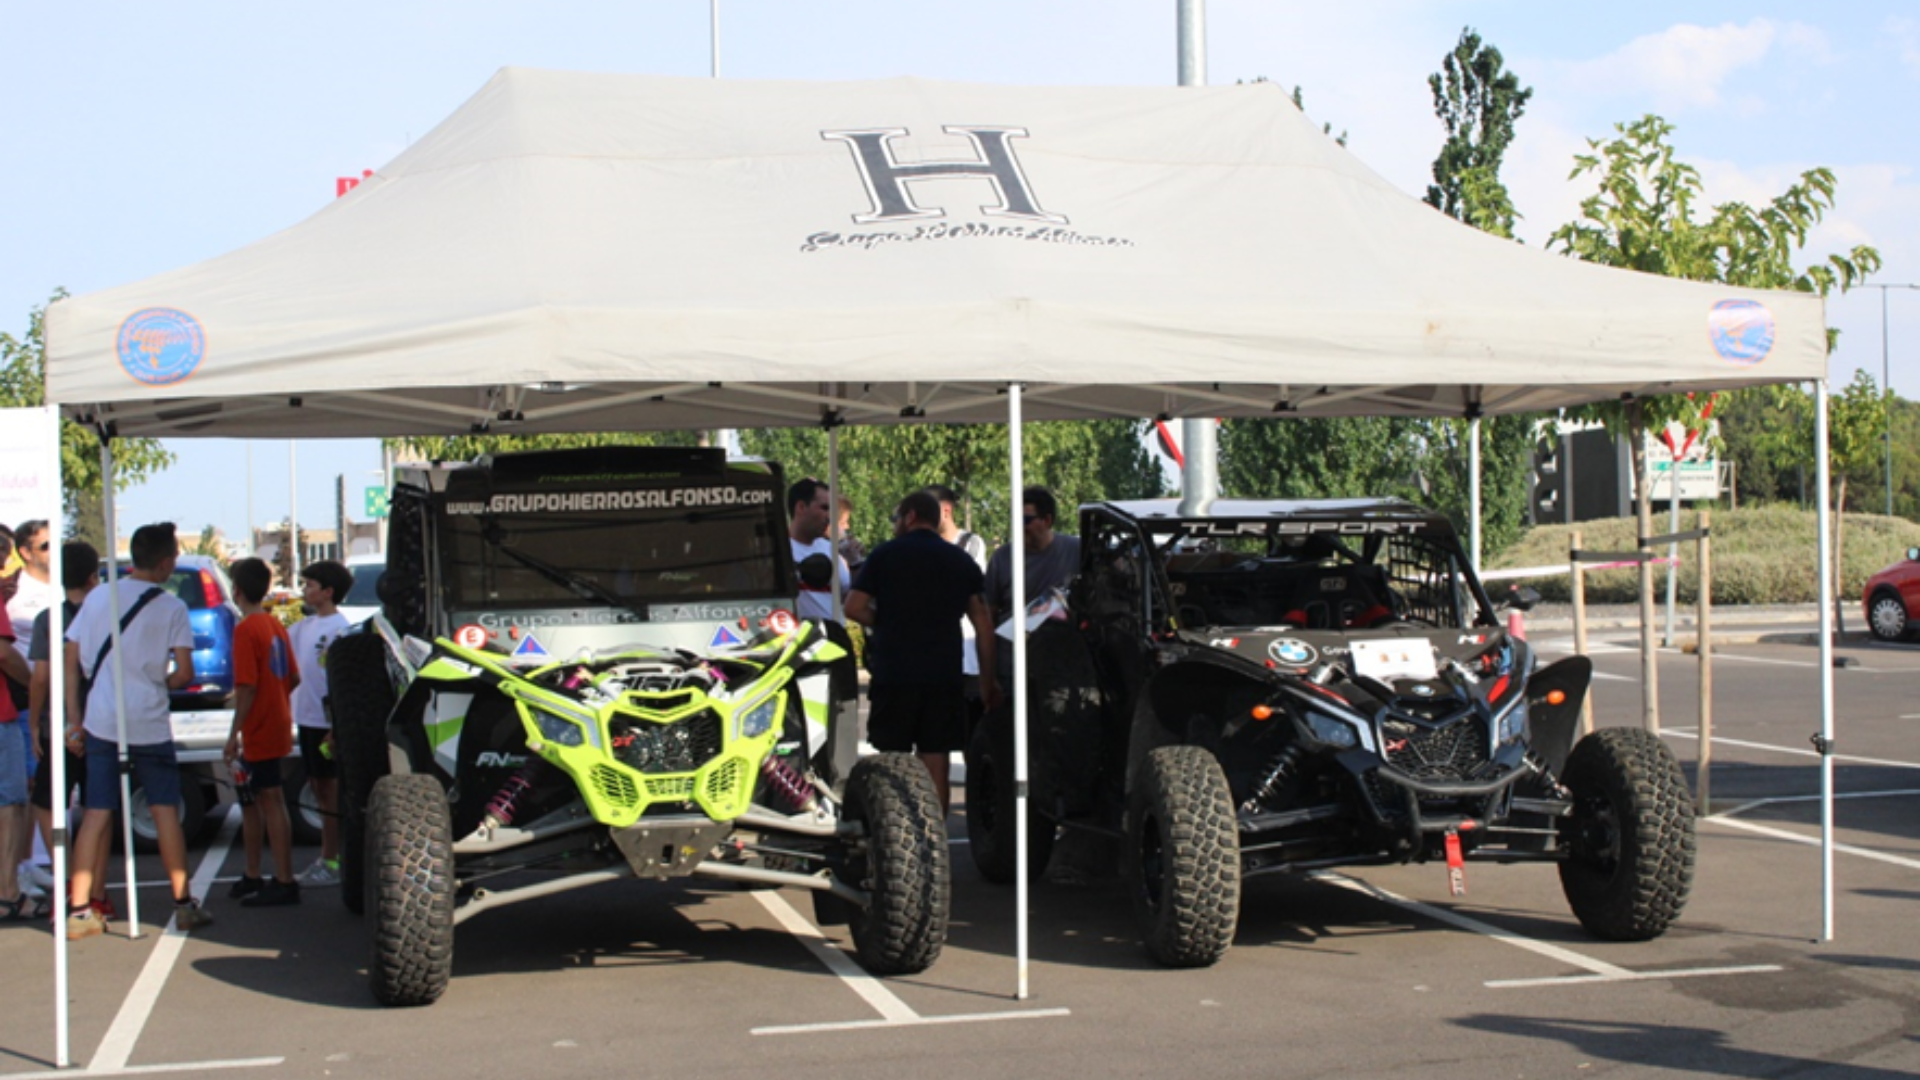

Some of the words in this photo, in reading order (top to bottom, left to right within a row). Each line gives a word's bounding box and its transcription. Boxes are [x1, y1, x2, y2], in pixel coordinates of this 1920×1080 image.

[819, 124, 1071, 225] H
[1181, 521, 1268, 535] TLR
[1278, 521, 1428, 535] SPORT
[477, 611, 564, 631] Grupo
[675, 604, 773, 621] Alfonso
